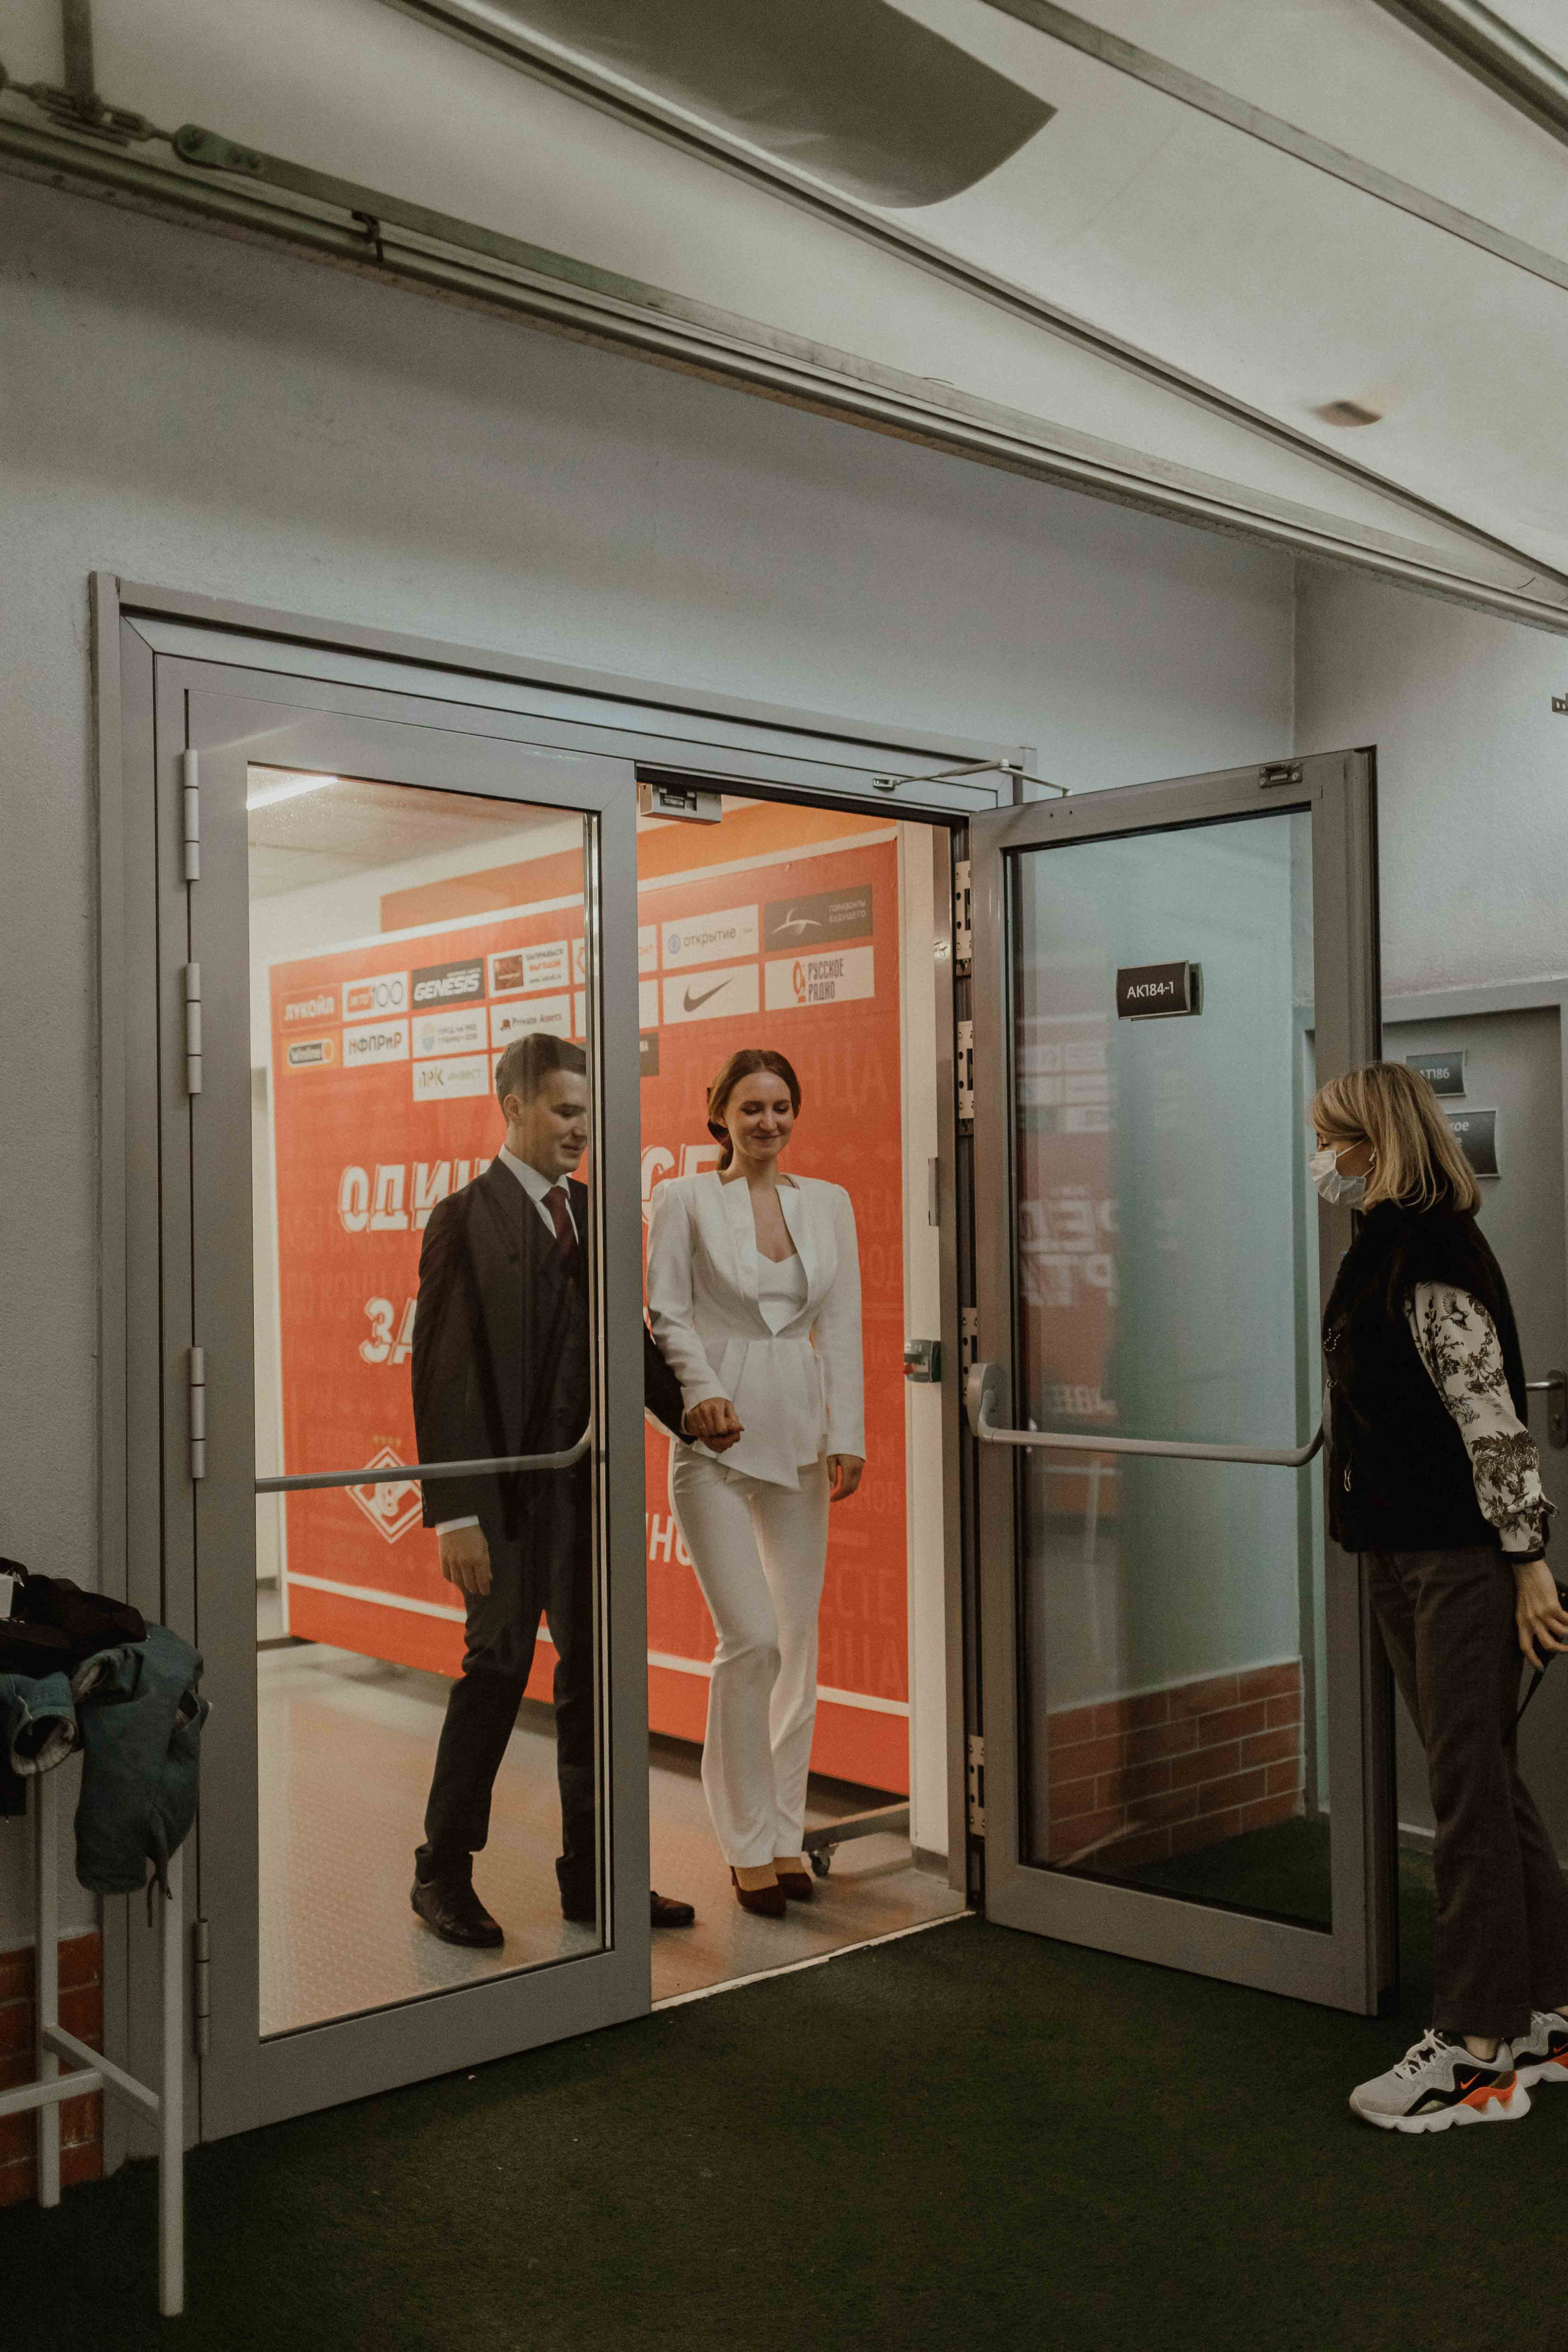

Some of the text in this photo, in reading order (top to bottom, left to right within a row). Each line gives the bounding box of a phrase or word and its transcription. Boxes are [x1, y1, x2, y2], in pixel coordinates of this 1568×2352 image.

[683, 927, 737, 947] открытие
[808, 958, 844, 981] РУССКОЕ
[413, 973, 480, 1001] GENESIS
[808, 981, 835, 1002] РАДИО
[1126, 981, 1174, 999] AK184-1
